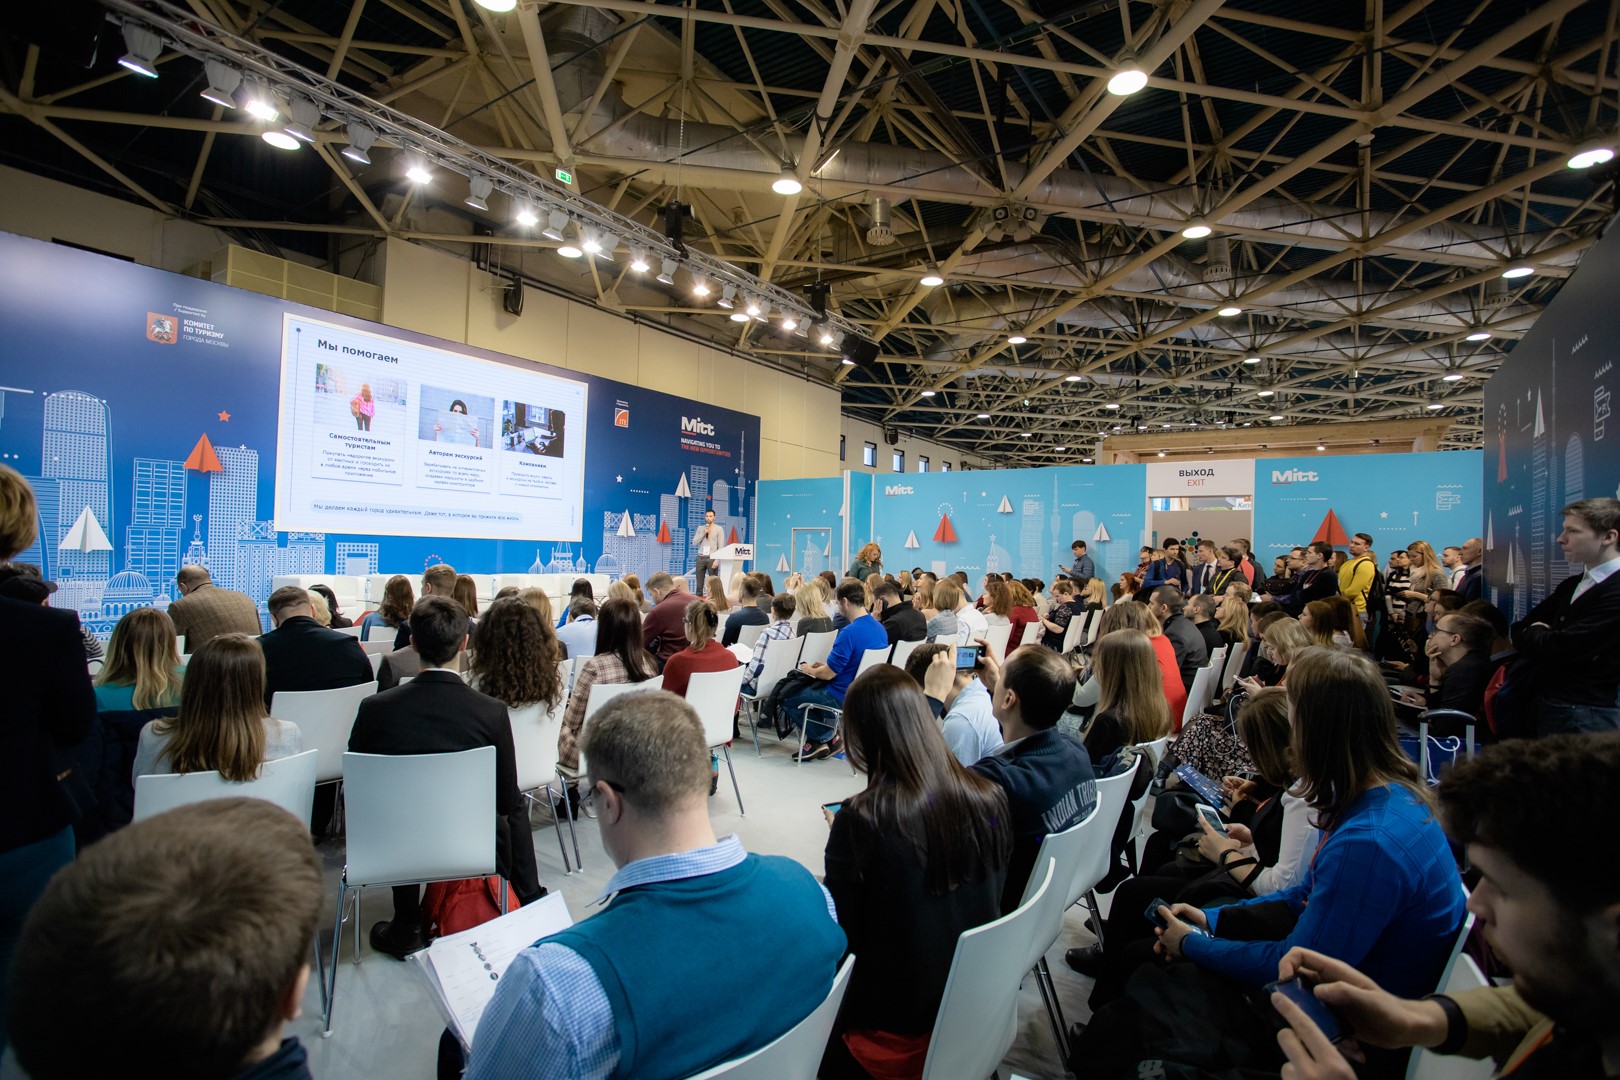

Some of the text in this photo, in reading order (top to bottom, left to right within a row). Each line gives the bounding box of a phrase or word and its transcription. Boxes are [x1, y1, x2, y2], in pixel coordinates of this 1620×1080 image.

[184, 319, 214, 330] КОМИТЕТ
[195, 328, 224, 339] ТУРИЗМУ
[183, 334, 229, 348] ГОРОДА МОСКВЫ
[318, 339, 398, 364] Мы помогаем
[682, 416, 715, 436] Mitt
[329, 433, 391, 445] Самостоятельным
[681, 438, 705, 447] NAVIGATING
[1179, 469, 1214, 477] ВЫХОД
[1272, 468, 1319, 482] Mitt
[885, 484, 913, 495] Mitt
[735, 547, 751, 555] Mitt
[1040, 788, 1078, 833] INDIAN
